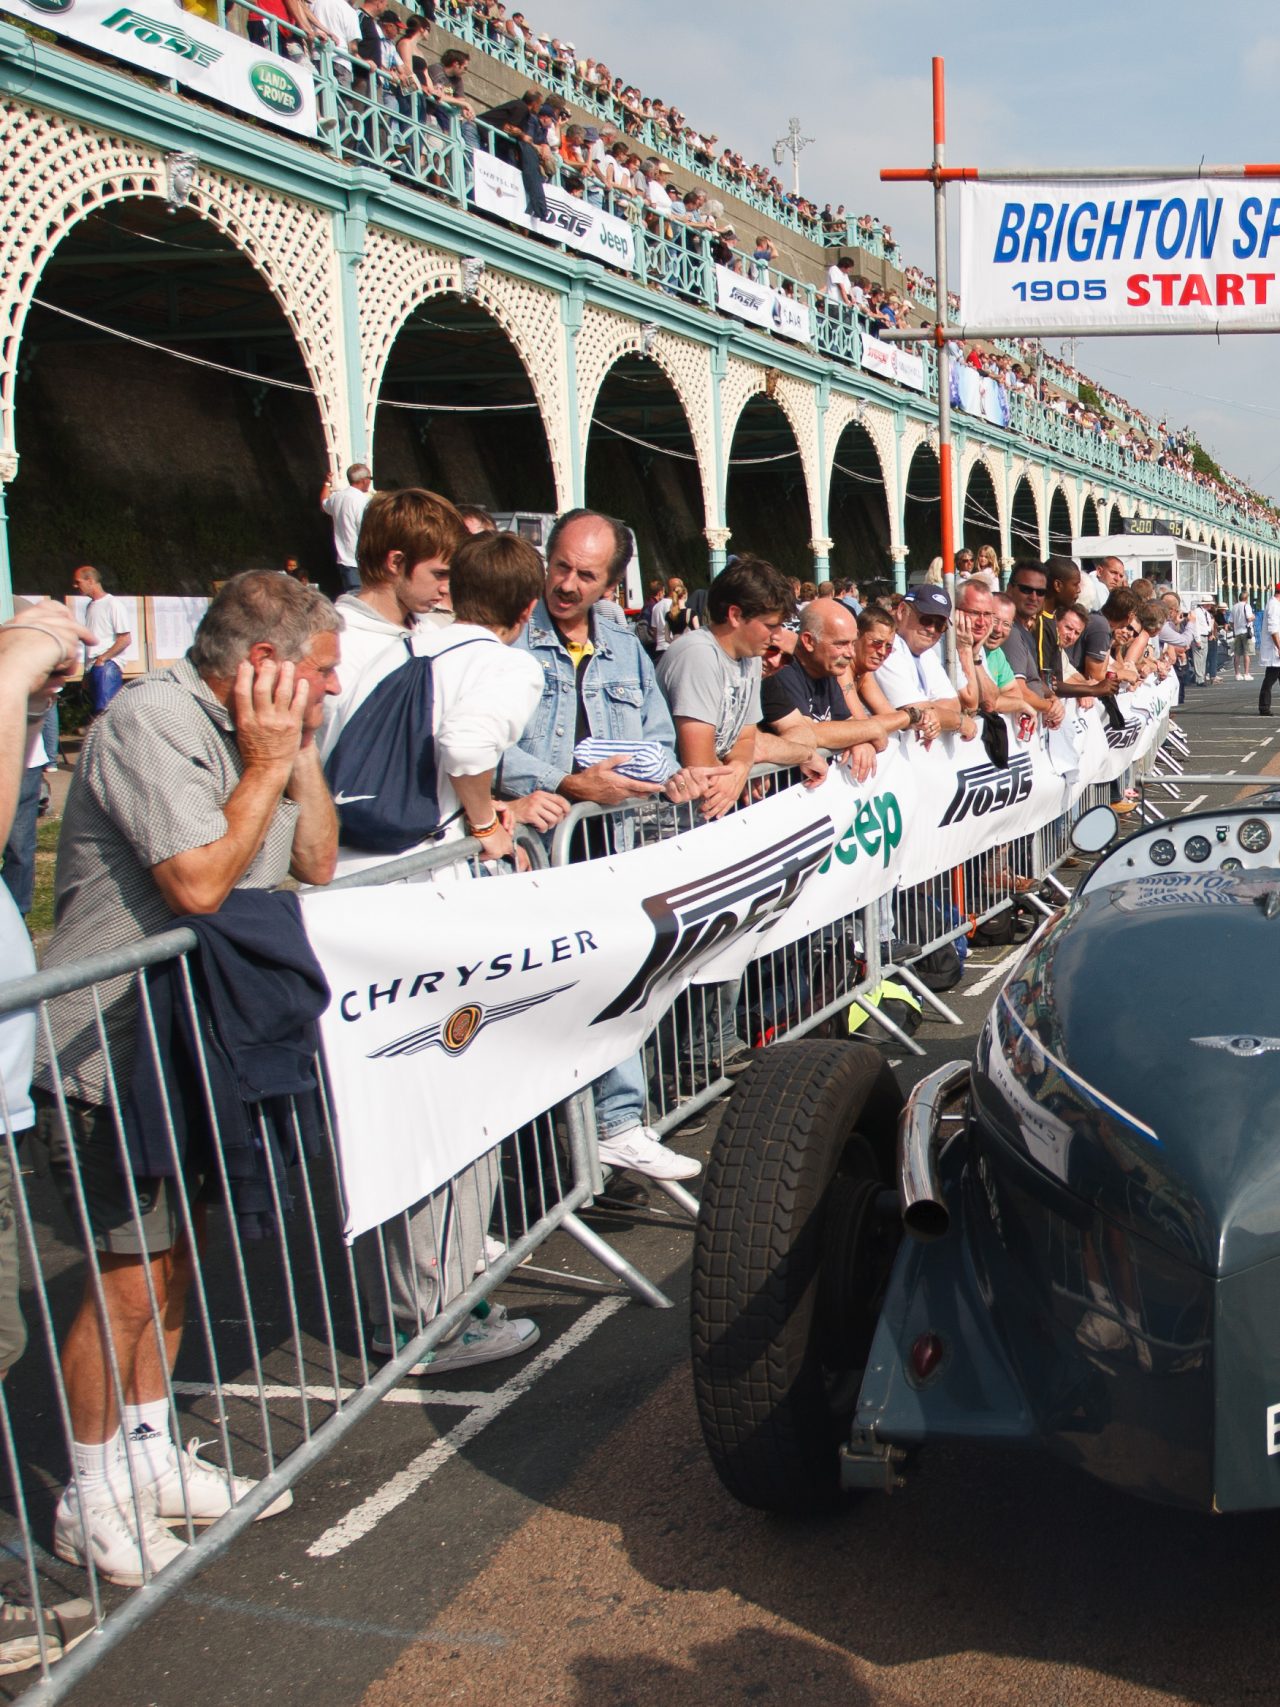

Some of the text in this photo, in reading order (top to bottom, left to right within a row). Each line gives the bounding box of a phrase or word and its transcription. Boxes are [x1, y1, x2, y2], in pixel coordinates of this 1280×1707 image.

[258, 68, 287, 91] LAND
[263, 84, 297, 110] ROVER
[600, 223, 628, 257] Jeep
[993, 197, 1224, 263] BRIGHTON
[1011, 279, 1106, 302] 1905
[1126, 273, 1275, 306] START
[339, 928, 598, 1023] CHRYSLER
